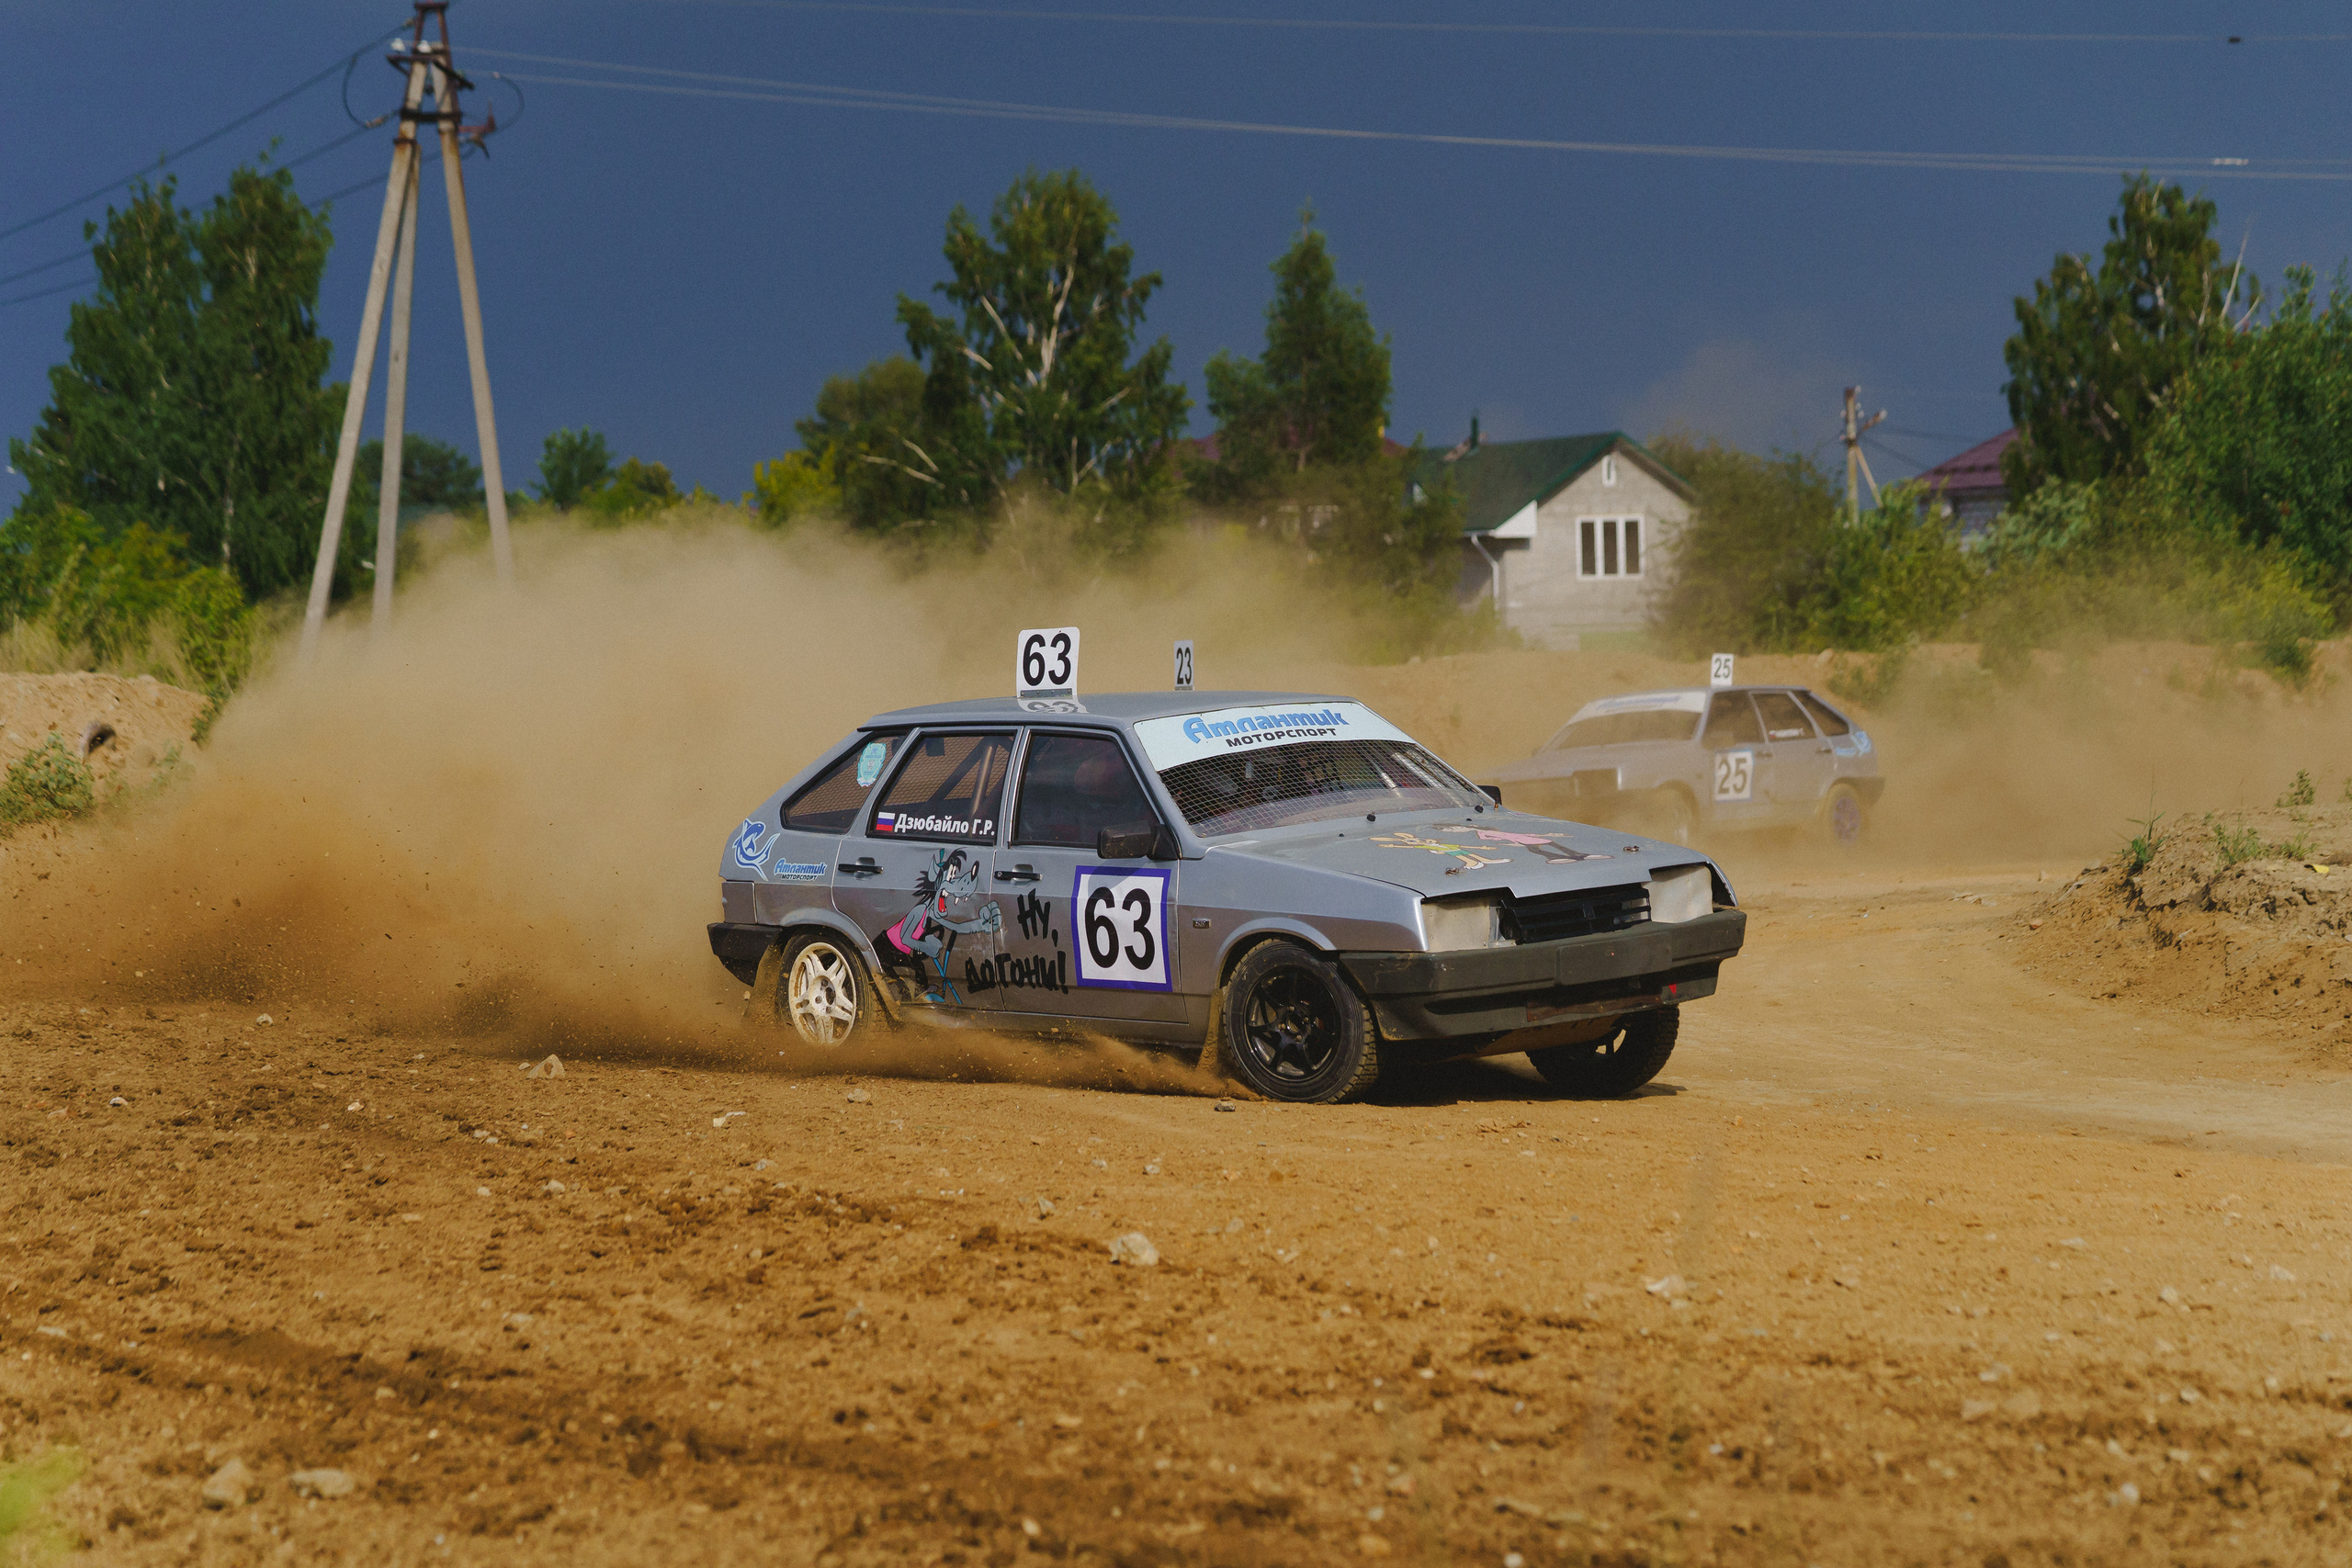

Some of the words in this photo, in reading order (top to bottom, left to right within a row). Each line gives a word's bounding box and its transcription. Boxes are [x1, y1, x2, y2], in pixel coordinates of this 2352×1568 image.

[1023, 632, 1071, 686] 63
[1176, 647, 1193, 685] 23
[1713, 658, 1731, 679] 25
[1183, 709, 1350, 744] Атлантик
[1226, 728, 1337, 747] МОТОРСПОРТ
[1717, 757, 1747, 795] 25
[894, 813, 969, 834] Дзюбайло
[972, 818, 996, 836] Г.Р.
[775, 858, 827, 876] Атлантик
[1017, 888, 1058, 947] Ну,
[1085, 886, 1155, 970] 63
